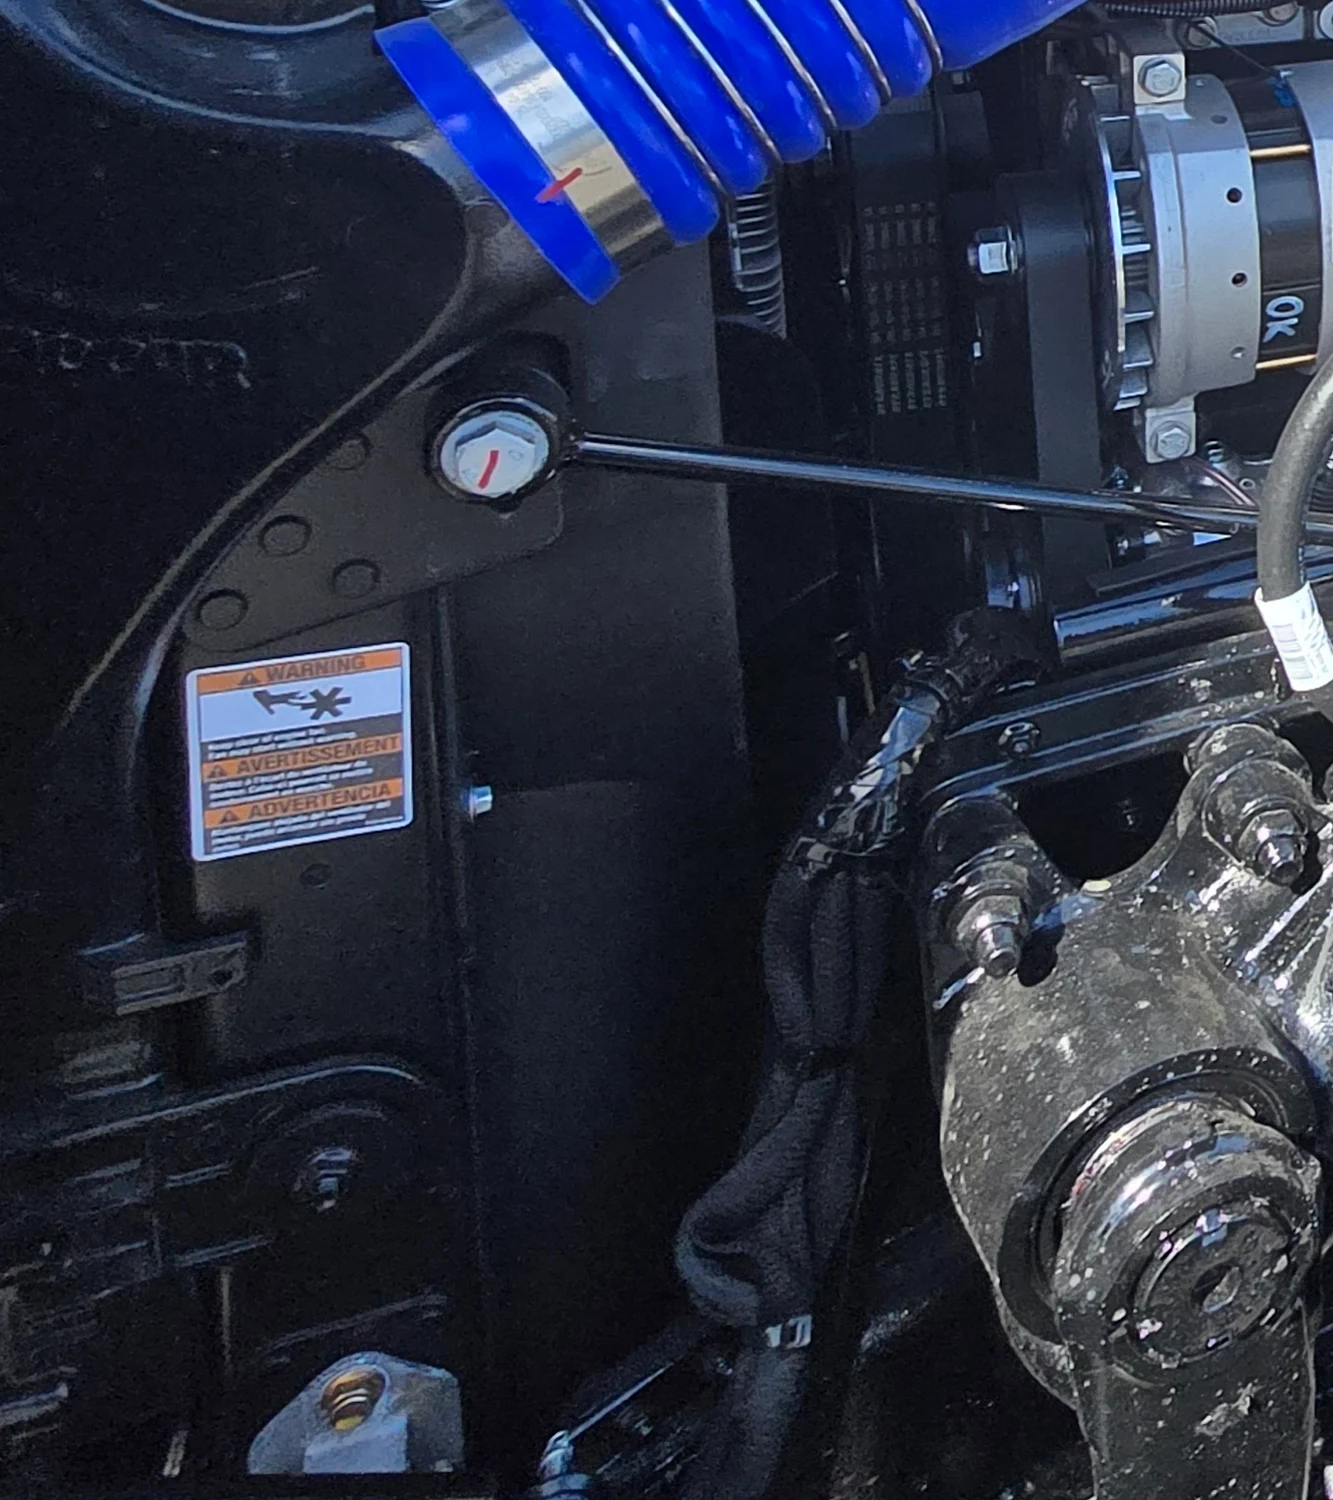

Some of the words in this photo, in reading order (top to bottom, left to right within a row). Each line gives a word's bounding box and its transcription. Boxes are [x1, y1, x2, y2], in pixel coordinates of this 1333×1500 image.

[1262, 295, 1305, 344] OK
[265, 654, 366, 682] WARNING
[236, 736, 399, 773] AVERTISSEMENT
[249, 783, 391, 818] ADVERTENCIA
